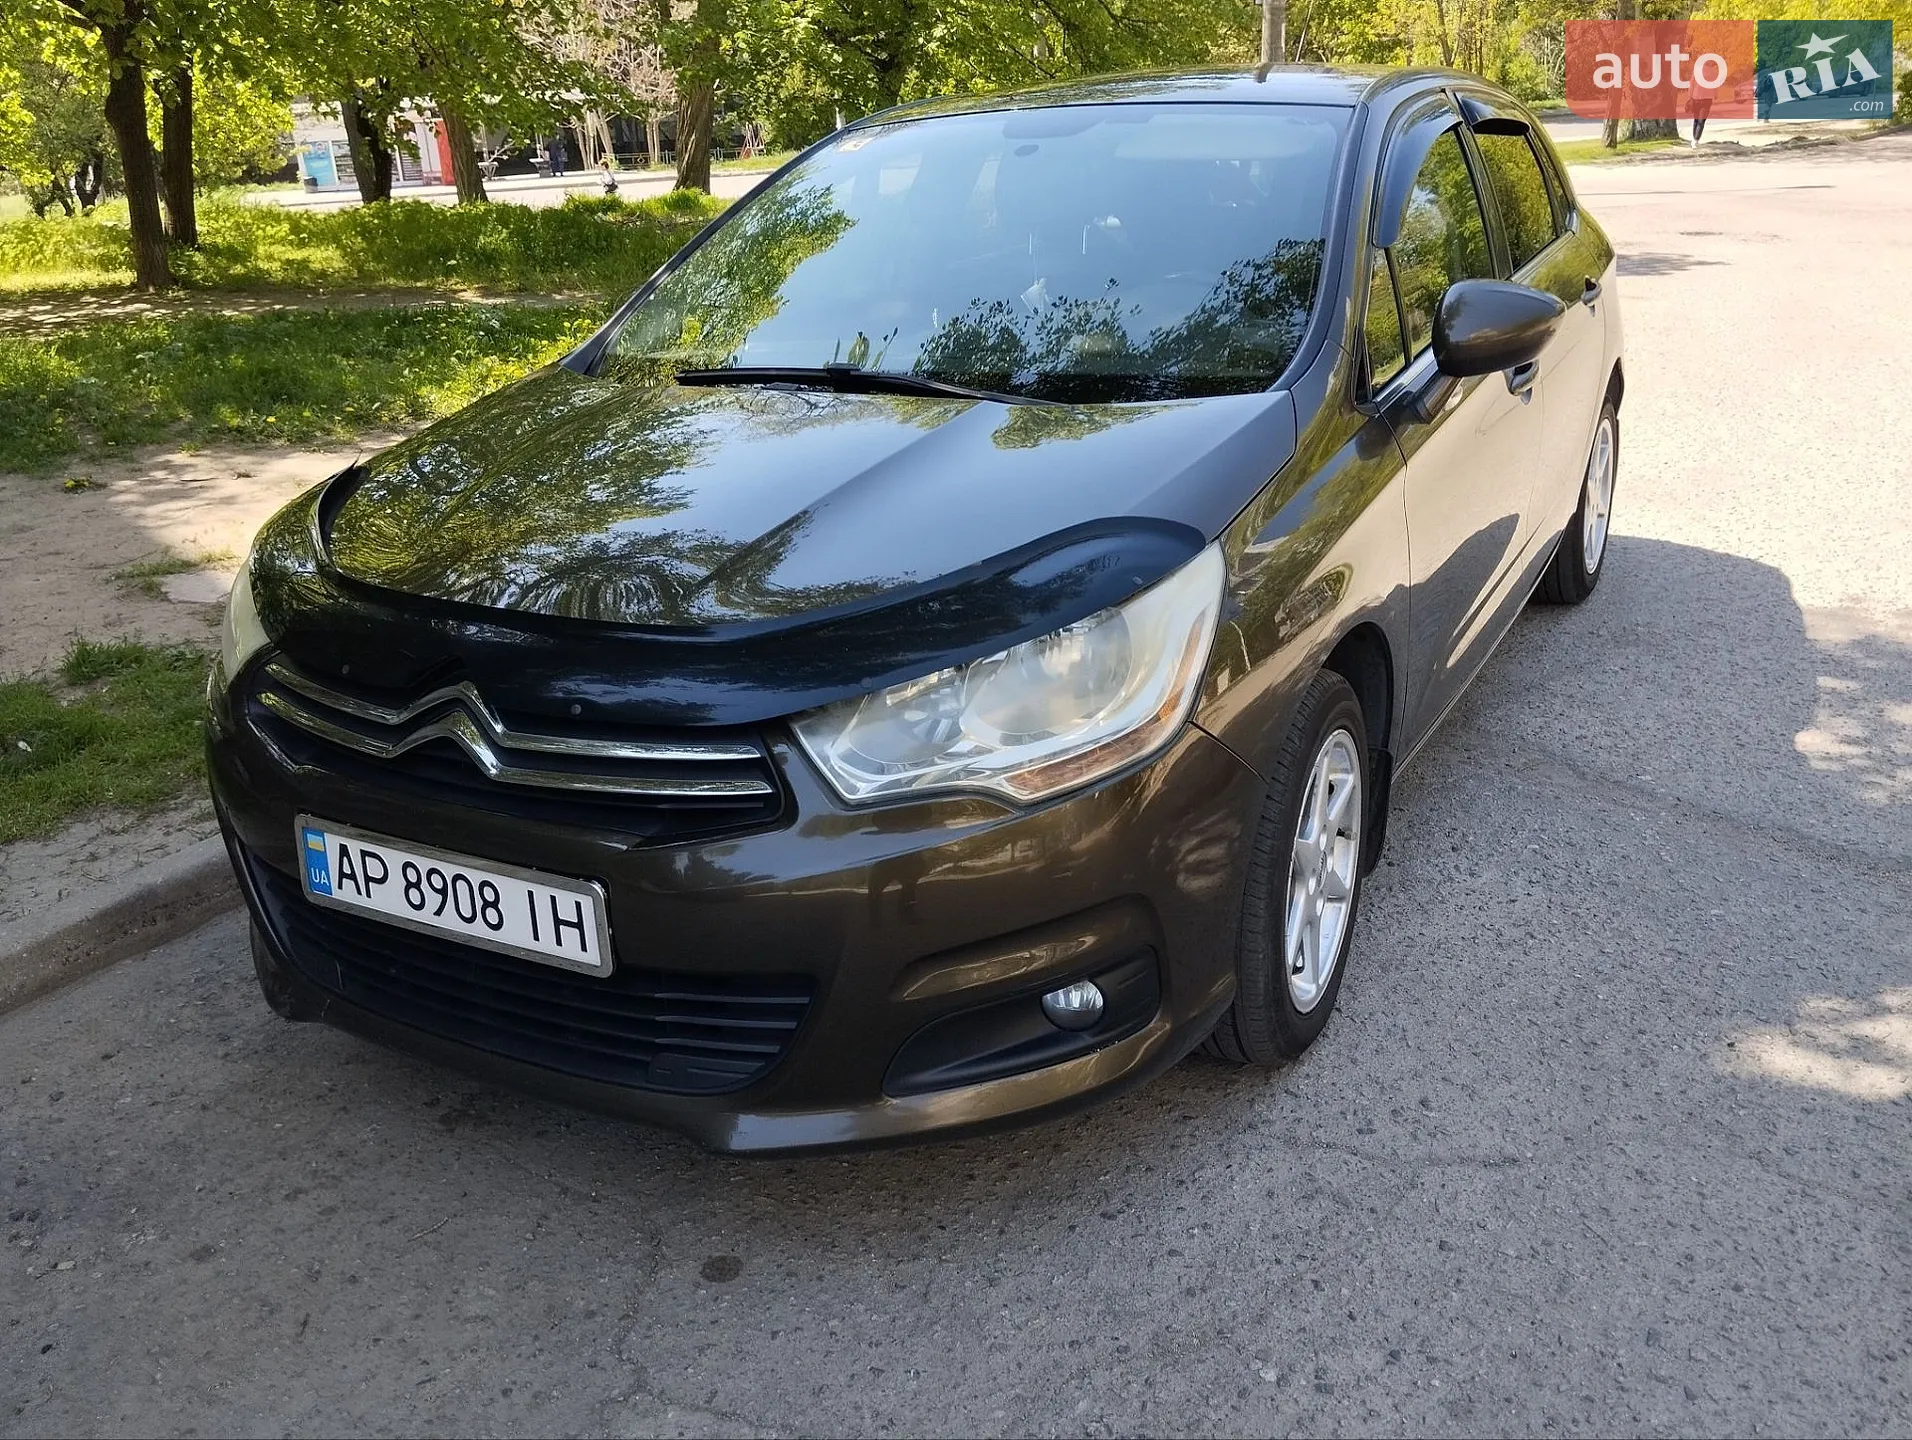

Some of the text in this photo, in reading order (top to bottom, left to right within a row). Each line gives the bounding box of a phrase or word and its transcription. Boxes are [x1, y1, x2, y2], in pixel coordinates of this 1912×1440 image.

[311, 868, 329, 887] UA
[337, 842, 588, 953] AP 8908 IH
